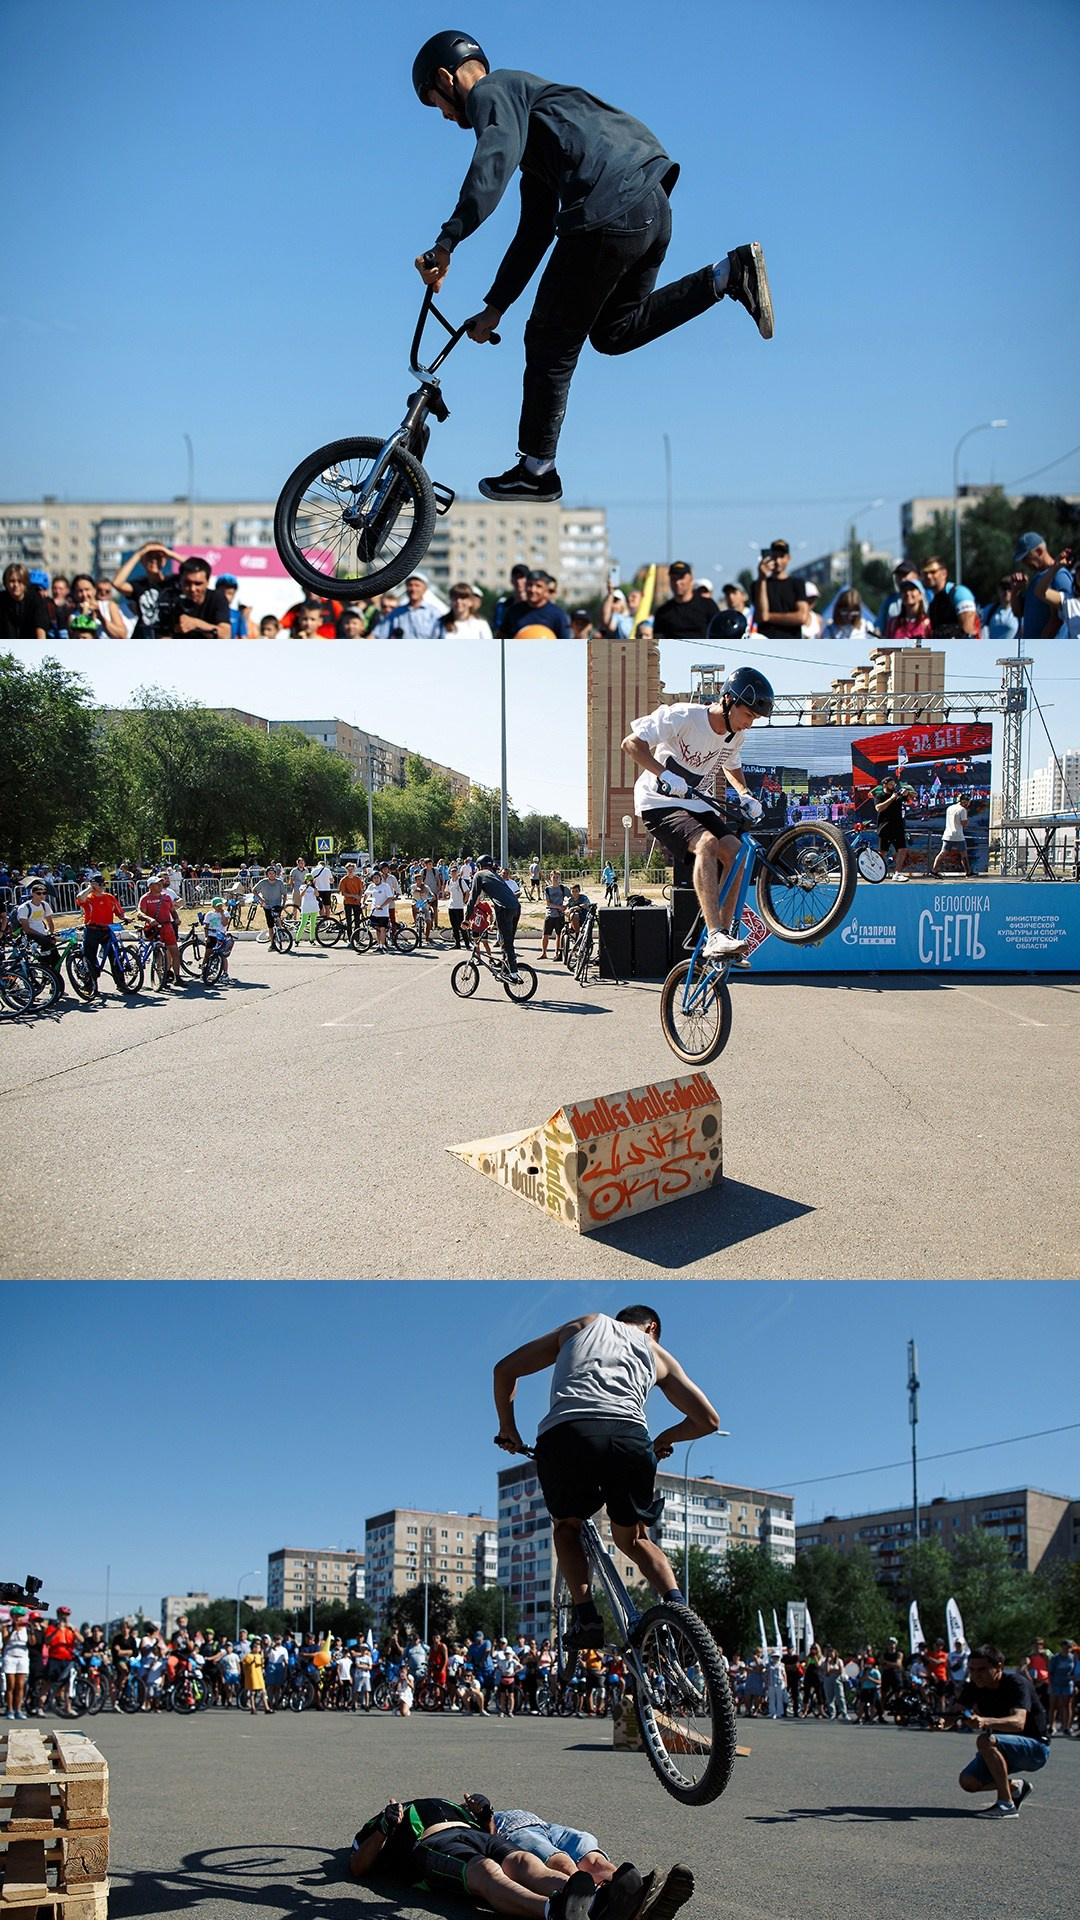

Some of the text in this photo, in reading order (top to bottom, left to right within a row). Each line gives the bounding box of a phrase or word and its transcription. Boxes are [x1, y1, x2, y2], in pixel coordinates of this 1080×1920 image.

[934, 895, 991, 912] ВЕЛОГОНКА
[859, 925, 896, 936] ГАЗПРОМ
[1005, 935, 1058, 943] ОРЕНБУРГСКОЙ
